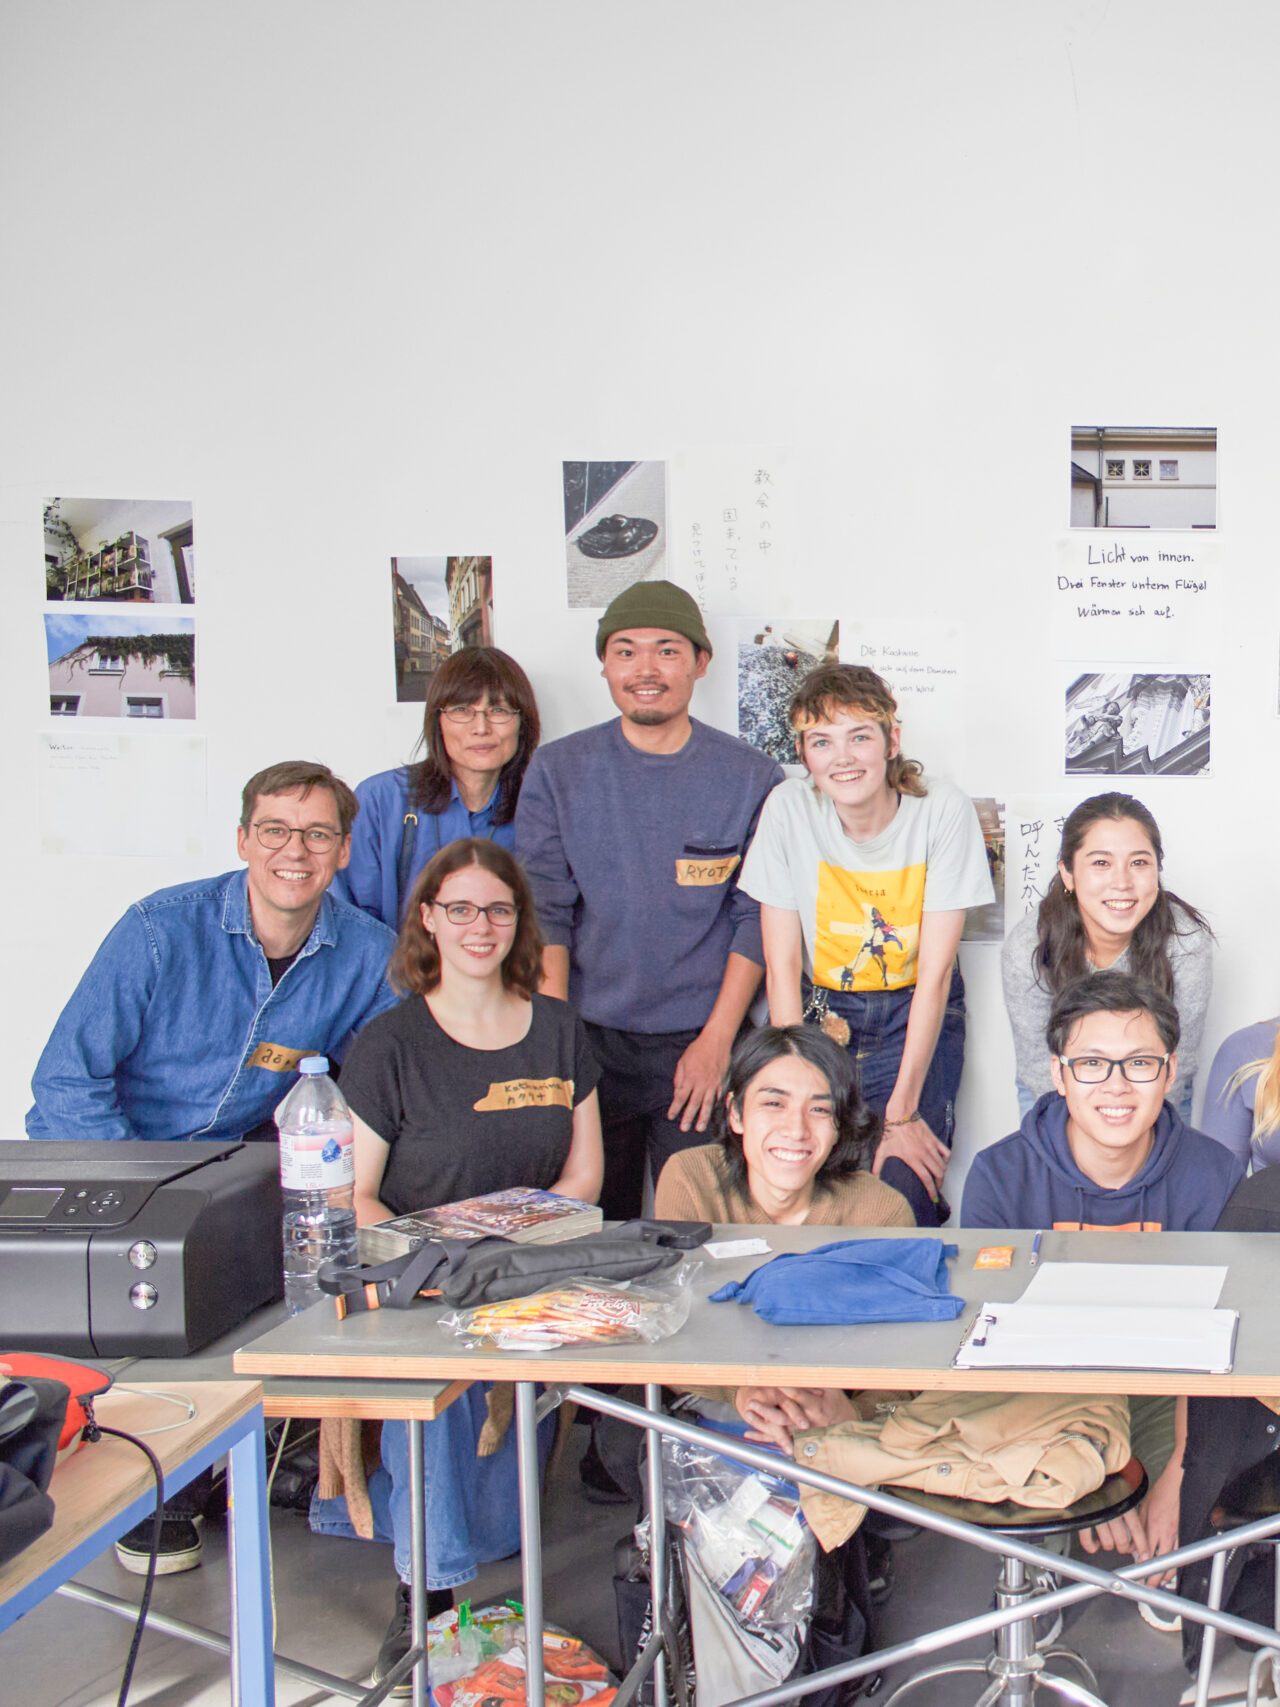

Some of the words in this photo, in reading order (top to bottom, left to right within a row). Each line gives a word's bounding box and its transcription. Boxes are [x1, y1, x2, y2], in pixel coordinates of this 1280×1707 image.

[1088, 543, 1126, 565] Licht
[1131, 553, 1149, 563] von
[1090, 576, 1127, 588] Fenster
[1175, 579, 1208, 593] Flügel
[1128, 605, 1146, 616] sich
